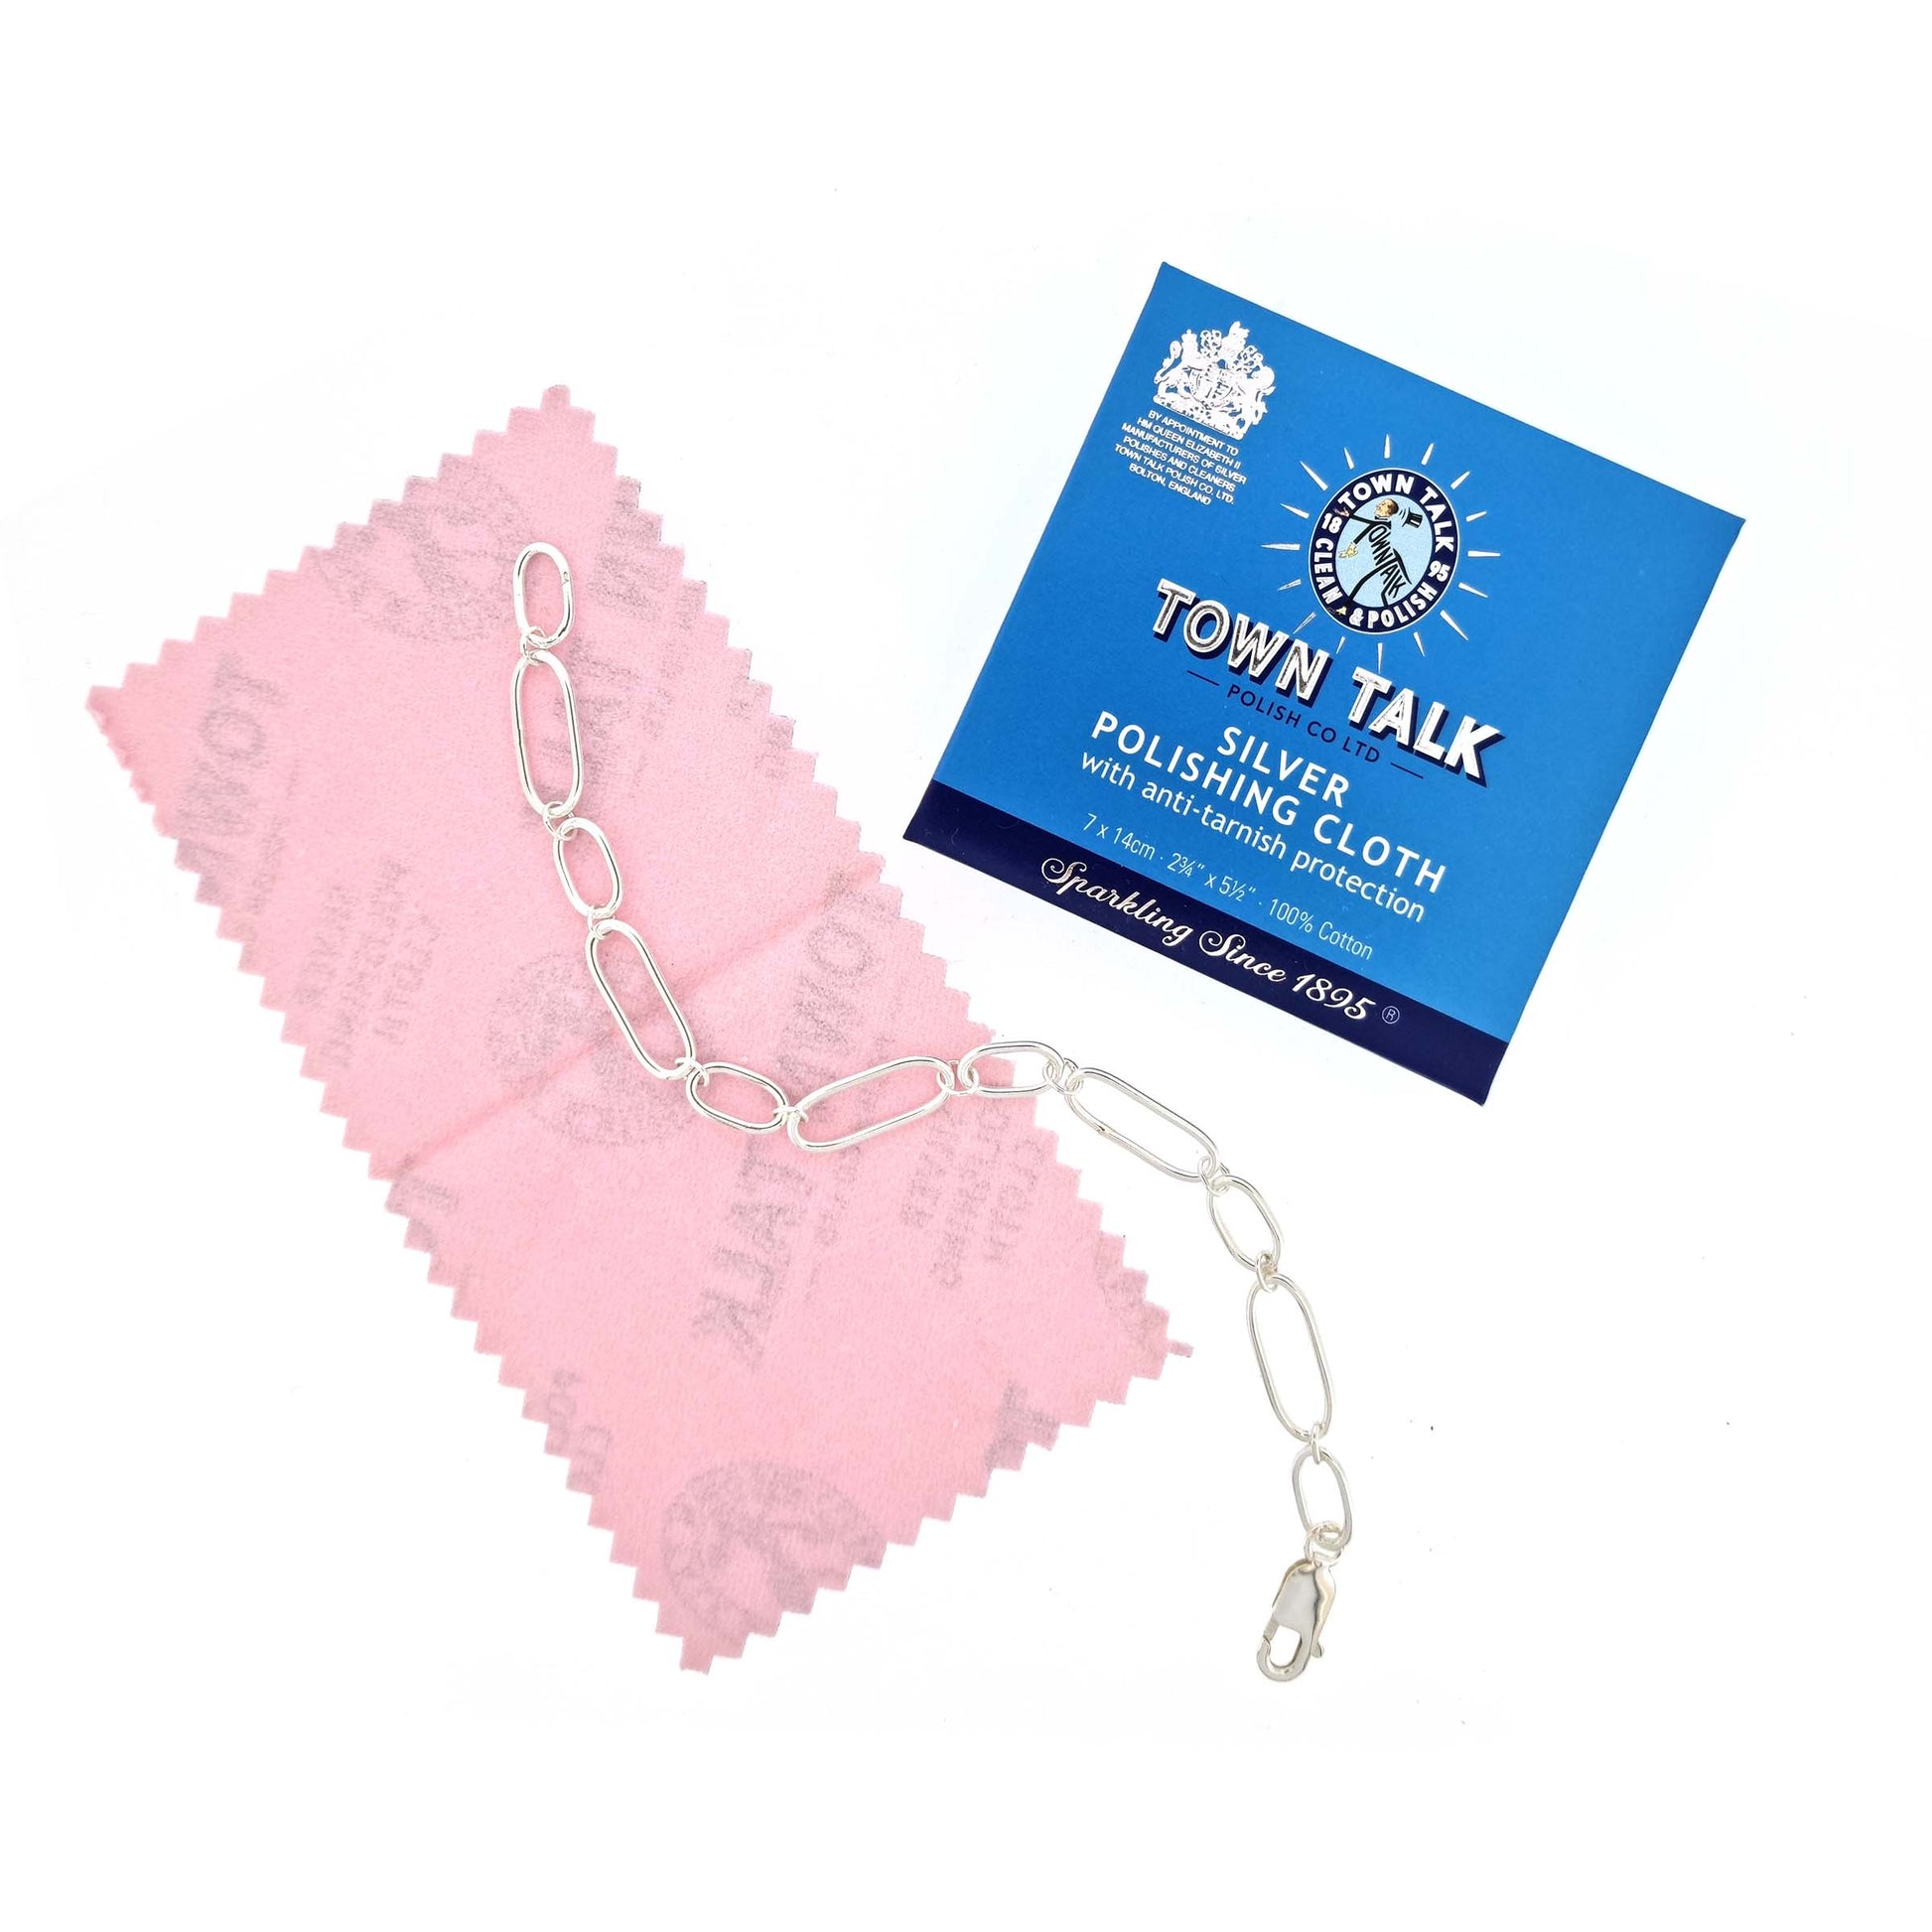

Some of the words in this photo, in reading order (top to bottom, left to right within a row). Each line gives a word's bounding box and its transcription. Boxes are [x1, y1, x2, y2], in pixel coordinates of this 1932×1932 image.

[1121, 422, 1201, 464] MANUFACTURERS
[1200, 458, 1216, 469] OF
[1214, 464, 1248, 485] SILVER
[1123, 435, 1169, 462] POLISHES
[1165, 456, 1188, 471] AND
[1187, 464, 1237, 492] CLEANERS
[1136, 416, 1154, 430] HM
[1152, 424, 1185, 445] QUEEN
[1184, 438, 1235, 467] ELIZABETH
[1233, 460, 1242, 471] II
[1148, 409, 1163, 421] BY
[1161, 416, 1230, 453] APPOINTMENT
[1225, 444, 1239, 457] TO
[1115, 443, 1143, 463] TOWN
[1143, 456, 1166, 473] TALK
[1165, 466, 1199, 487] POLISH
[1198, 482, 1214, 495] CO.
[1215, 489, 1234, 505] LTD.
[1129, 462, 1167, 487] BOLTON,
[1168, 480, 1212, 505] ENGLAND
[1337, 473, 1415, 510] TOWN
[1419, 485, 1455, 555] TALK
[1320, 512, 1342, 535] 18
[1312, 536, 1343, 606] CLEAN
[1366, 581, 1440, 629] POLISH
[1429, 560, 1451, 583] 95
[1152, 578, 1330, 701] TOWN
[1347, 665, 1501, 778] TALK
[1226, 683, 1302, 729] POLISH
[1307, 720, 1337, 744] CO
[1341, 736, 1380, 763] LTD
[1091, 710, 1301, 826] POLISHING
[1313, 813, 1447, 894] CLOTH
[1216, 726, 1349, 808] SILVER
[1082, 752, 1136, 790] with
[1141, 781, 1287, 860] anti-tarnish
[1290, 850, 1425, 923] protection
[1083, 813, 1097, 831] 7
[1096, 824, 1109, 839] x
[1113, 827, 1156, 861] 14cm
[1203, 873, 1217, 889] x
[1269, 898, 1314, 933] 100%
[1318, 920, 1373, 961] Cotton
[1040, 857, 1194, 947] Sparkling
[1198, 929, 1287, 983] Since
[1292, 973, 1377, 1021] 1895
